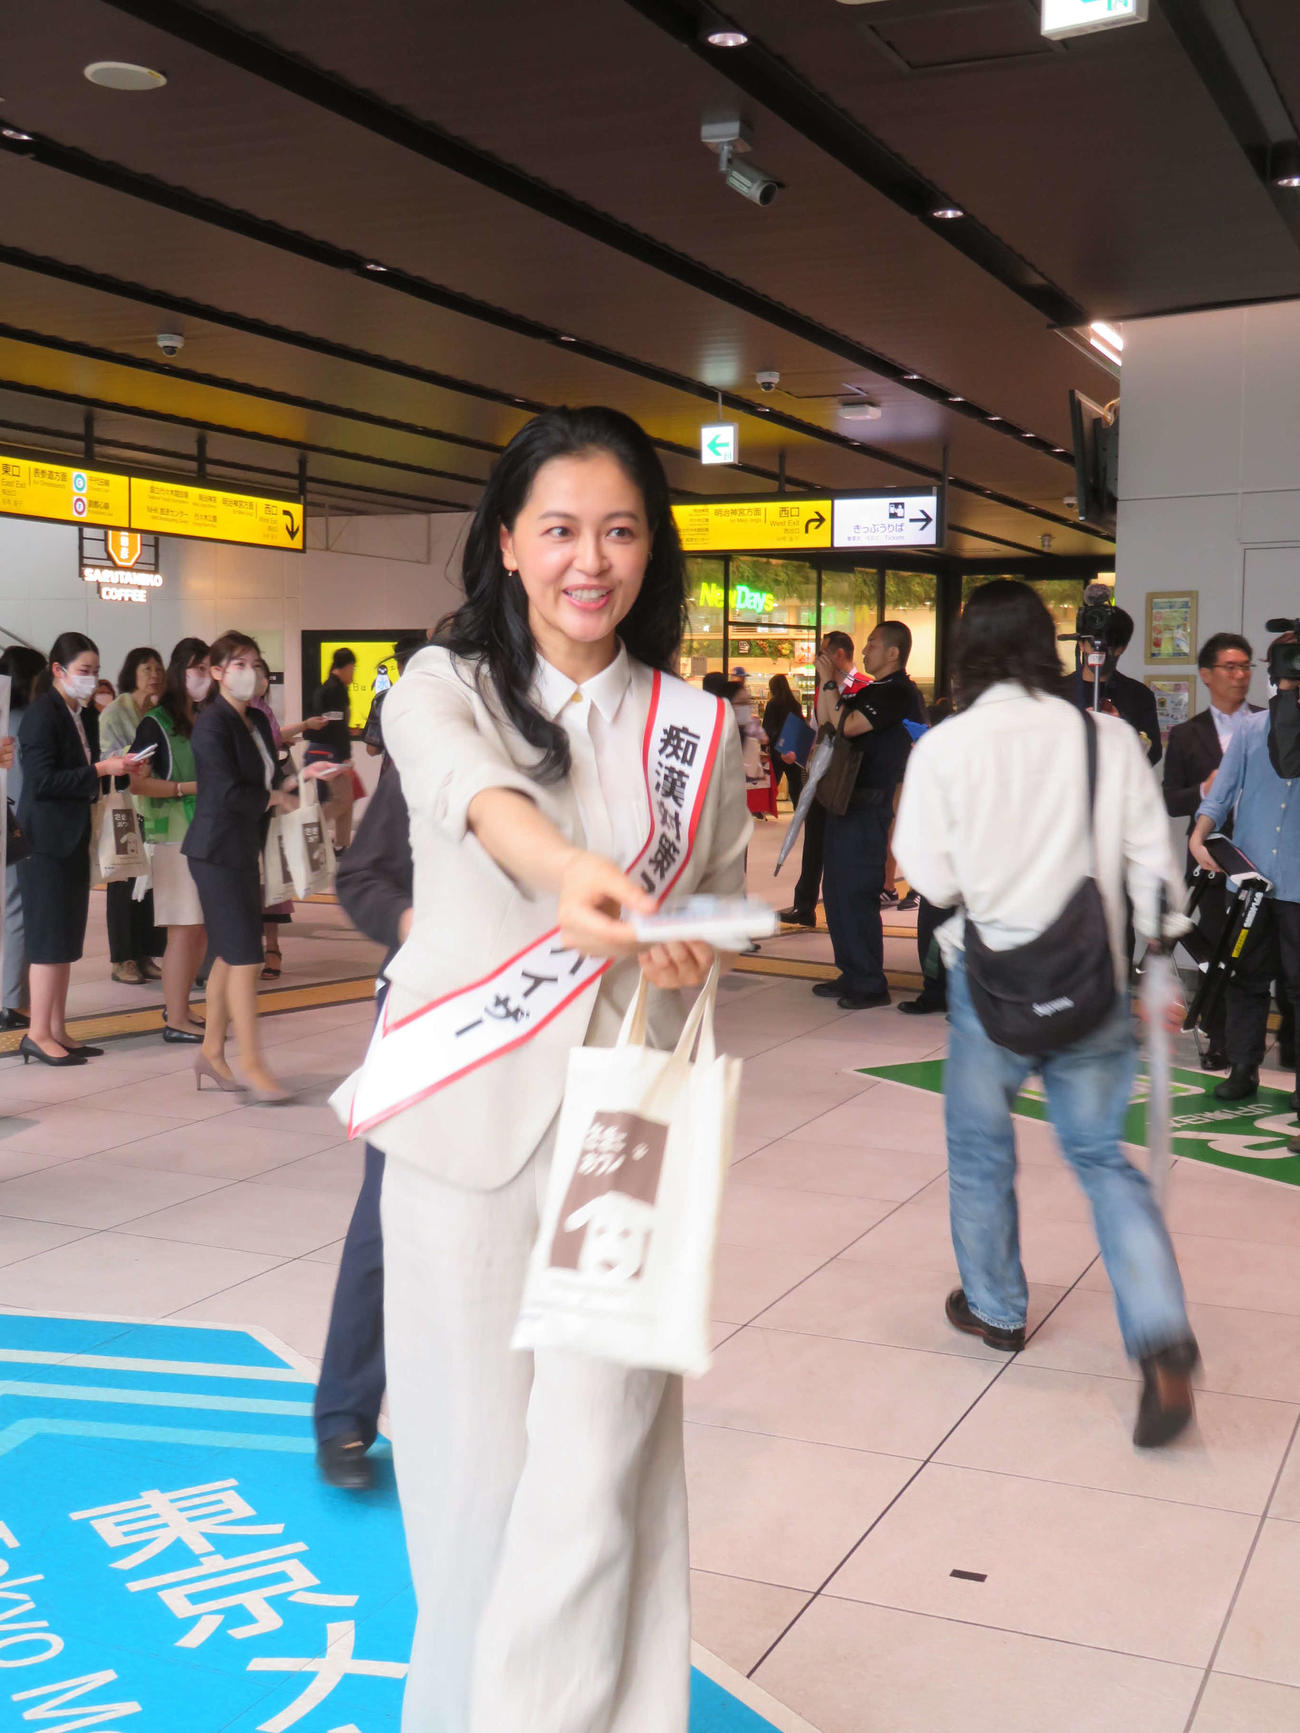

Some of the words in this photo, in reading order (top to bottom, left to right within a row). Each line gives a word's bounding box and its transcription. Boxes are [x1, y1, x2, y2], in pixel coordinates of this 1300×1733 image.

[2, 463, 20, 477] 東口
[714, 507, 761, 517] 明治神宮方面
[779, 506, 800, 518] 西口
[853, 523, 905, 534] きっぷうりば
[101, 586, 147, 602] COFFEE
[699, 582, 775, 614] NewDays
[69, 1478, 408, 1733] 東京メ
